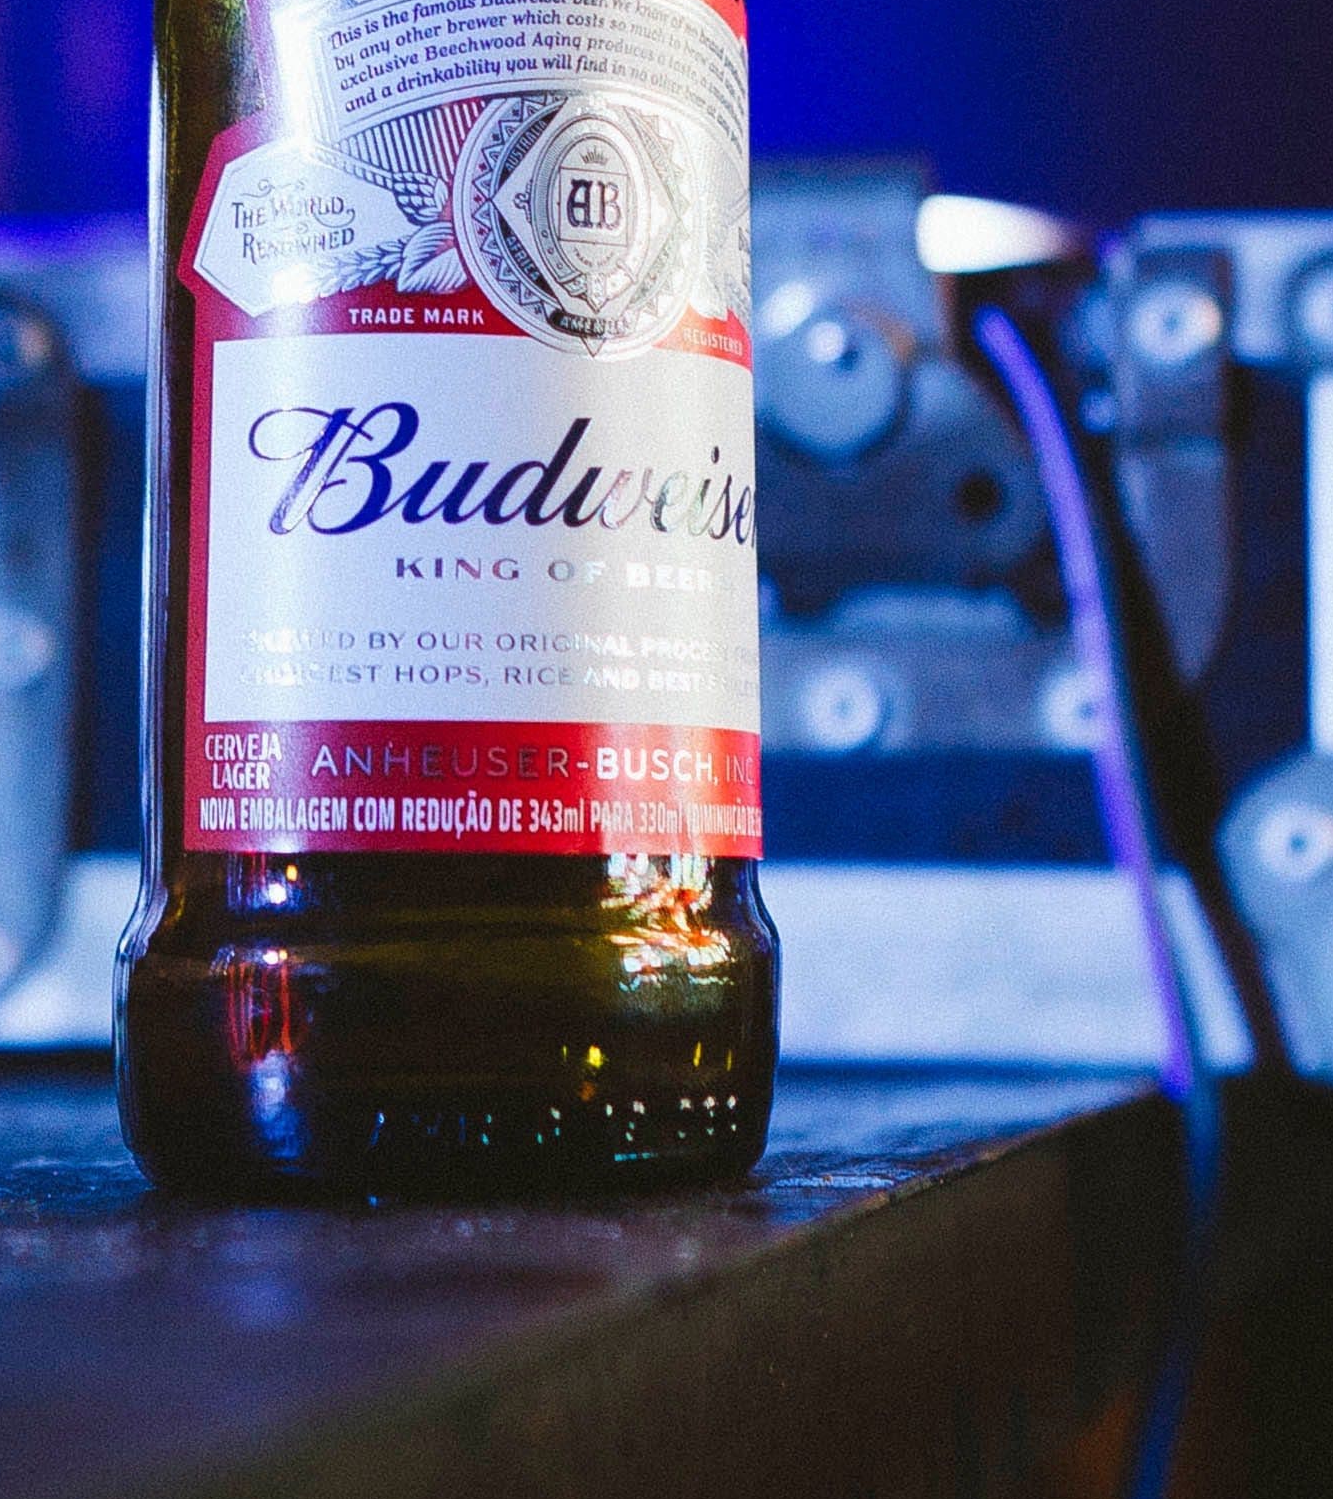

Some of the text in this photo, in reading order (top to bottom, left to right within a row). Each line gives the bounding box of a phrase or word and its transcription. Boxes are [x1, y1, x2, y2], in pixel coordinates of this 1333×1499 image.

[329, 25, 362, 51] This
[366, 19, 380, 36] is
[382, 8, 409, 30] the
[334, 54, 355, 72] by
[359, 40, 390, 61] any
[395, 23, 442, 48] other
[447, 14, 508, 35] brewer
[512, 9, 561, 26] which
[567, 12, 605, 29] costs
[609, 18, 627, 31] so
[630, 22, 665, 44] much
[340, 52, 418, 92] exclusive
[424, 32, 526, 62] Beechwood
[532, 32, 581, 50] Aging
[586, 37, 655, 62] produces
[344, 84, 378, 114] and
[381, 85, 393, 99] a
[397, 58, 501, 95] drinkability
[506, 58, 538, 76] you
[543, 52, 573, 71] will
[575, 54, 609, 75] find
[611, 58, 626, 77] in
[630, 67, 648, 83] no
[504, 119, 547, 172] AUSTRALIA
[231, 202, 267, 229] THE
[566, 178, 623, 232] AB
[505, 234, 542, 283] AFRICA
[348, 307, 485, 326] TRADE MARK
[394, 556, 725, 592] KING OF BEER
[368, 631, 406, 651] BY
[416, 631, 484, 651] OUR
[495, 631, 637, 658] ORIGINAL
[395, 664, 490, 687] HOPS,
[503, 665, 573, 687] RICE
[582, 665, 641, 691] AND
[646, 668, 703, 693] BEST
[204, 731, 283, 762] CERVEJA
[212, 761, 271, 791] LAGER
[199, 797, 236, 832] NOVA
[239, 796, 348, 832] EMBALAGEM
[352, 796, 396, 832] COM
[401, 789, 493, 840] REDUÇÃO
[498, 797, 523, 833] DE
[528, 797, 585, 834] 343ml
[590, 799, 634, 834] PARA
[638, 799, 684, 835] 330ml
